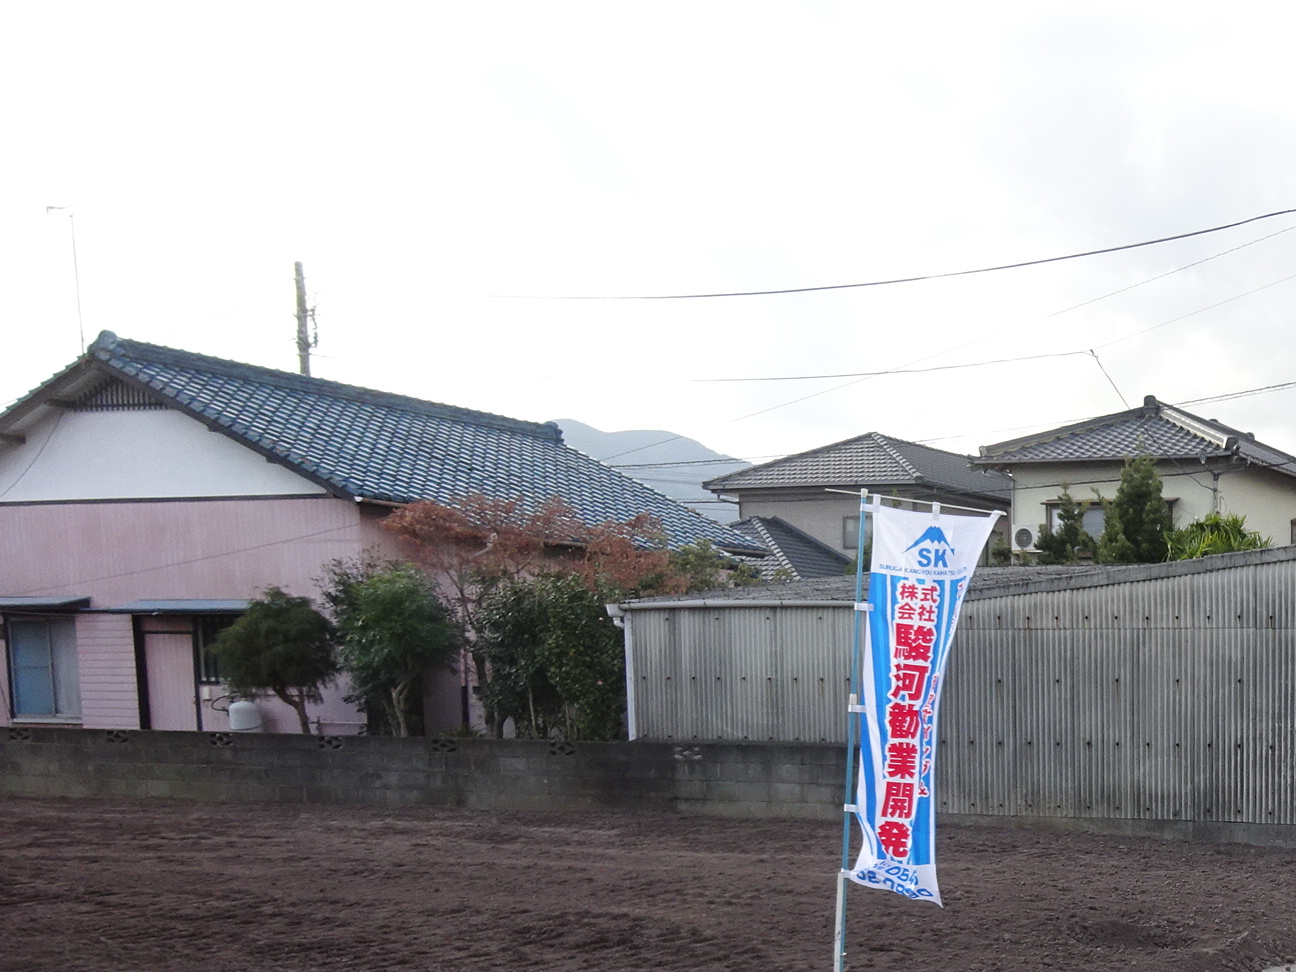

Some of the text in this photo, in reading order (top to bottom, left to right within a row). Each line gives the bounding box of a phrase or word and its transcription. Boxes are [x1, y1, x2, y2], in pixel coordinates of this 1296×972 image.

[917, 548, 948, 568] SK
[899, 583, 938, 604] 株式
[898, 602, 936, 623] 会社
[877, 623, 936, 858] 駿河勧業開発
